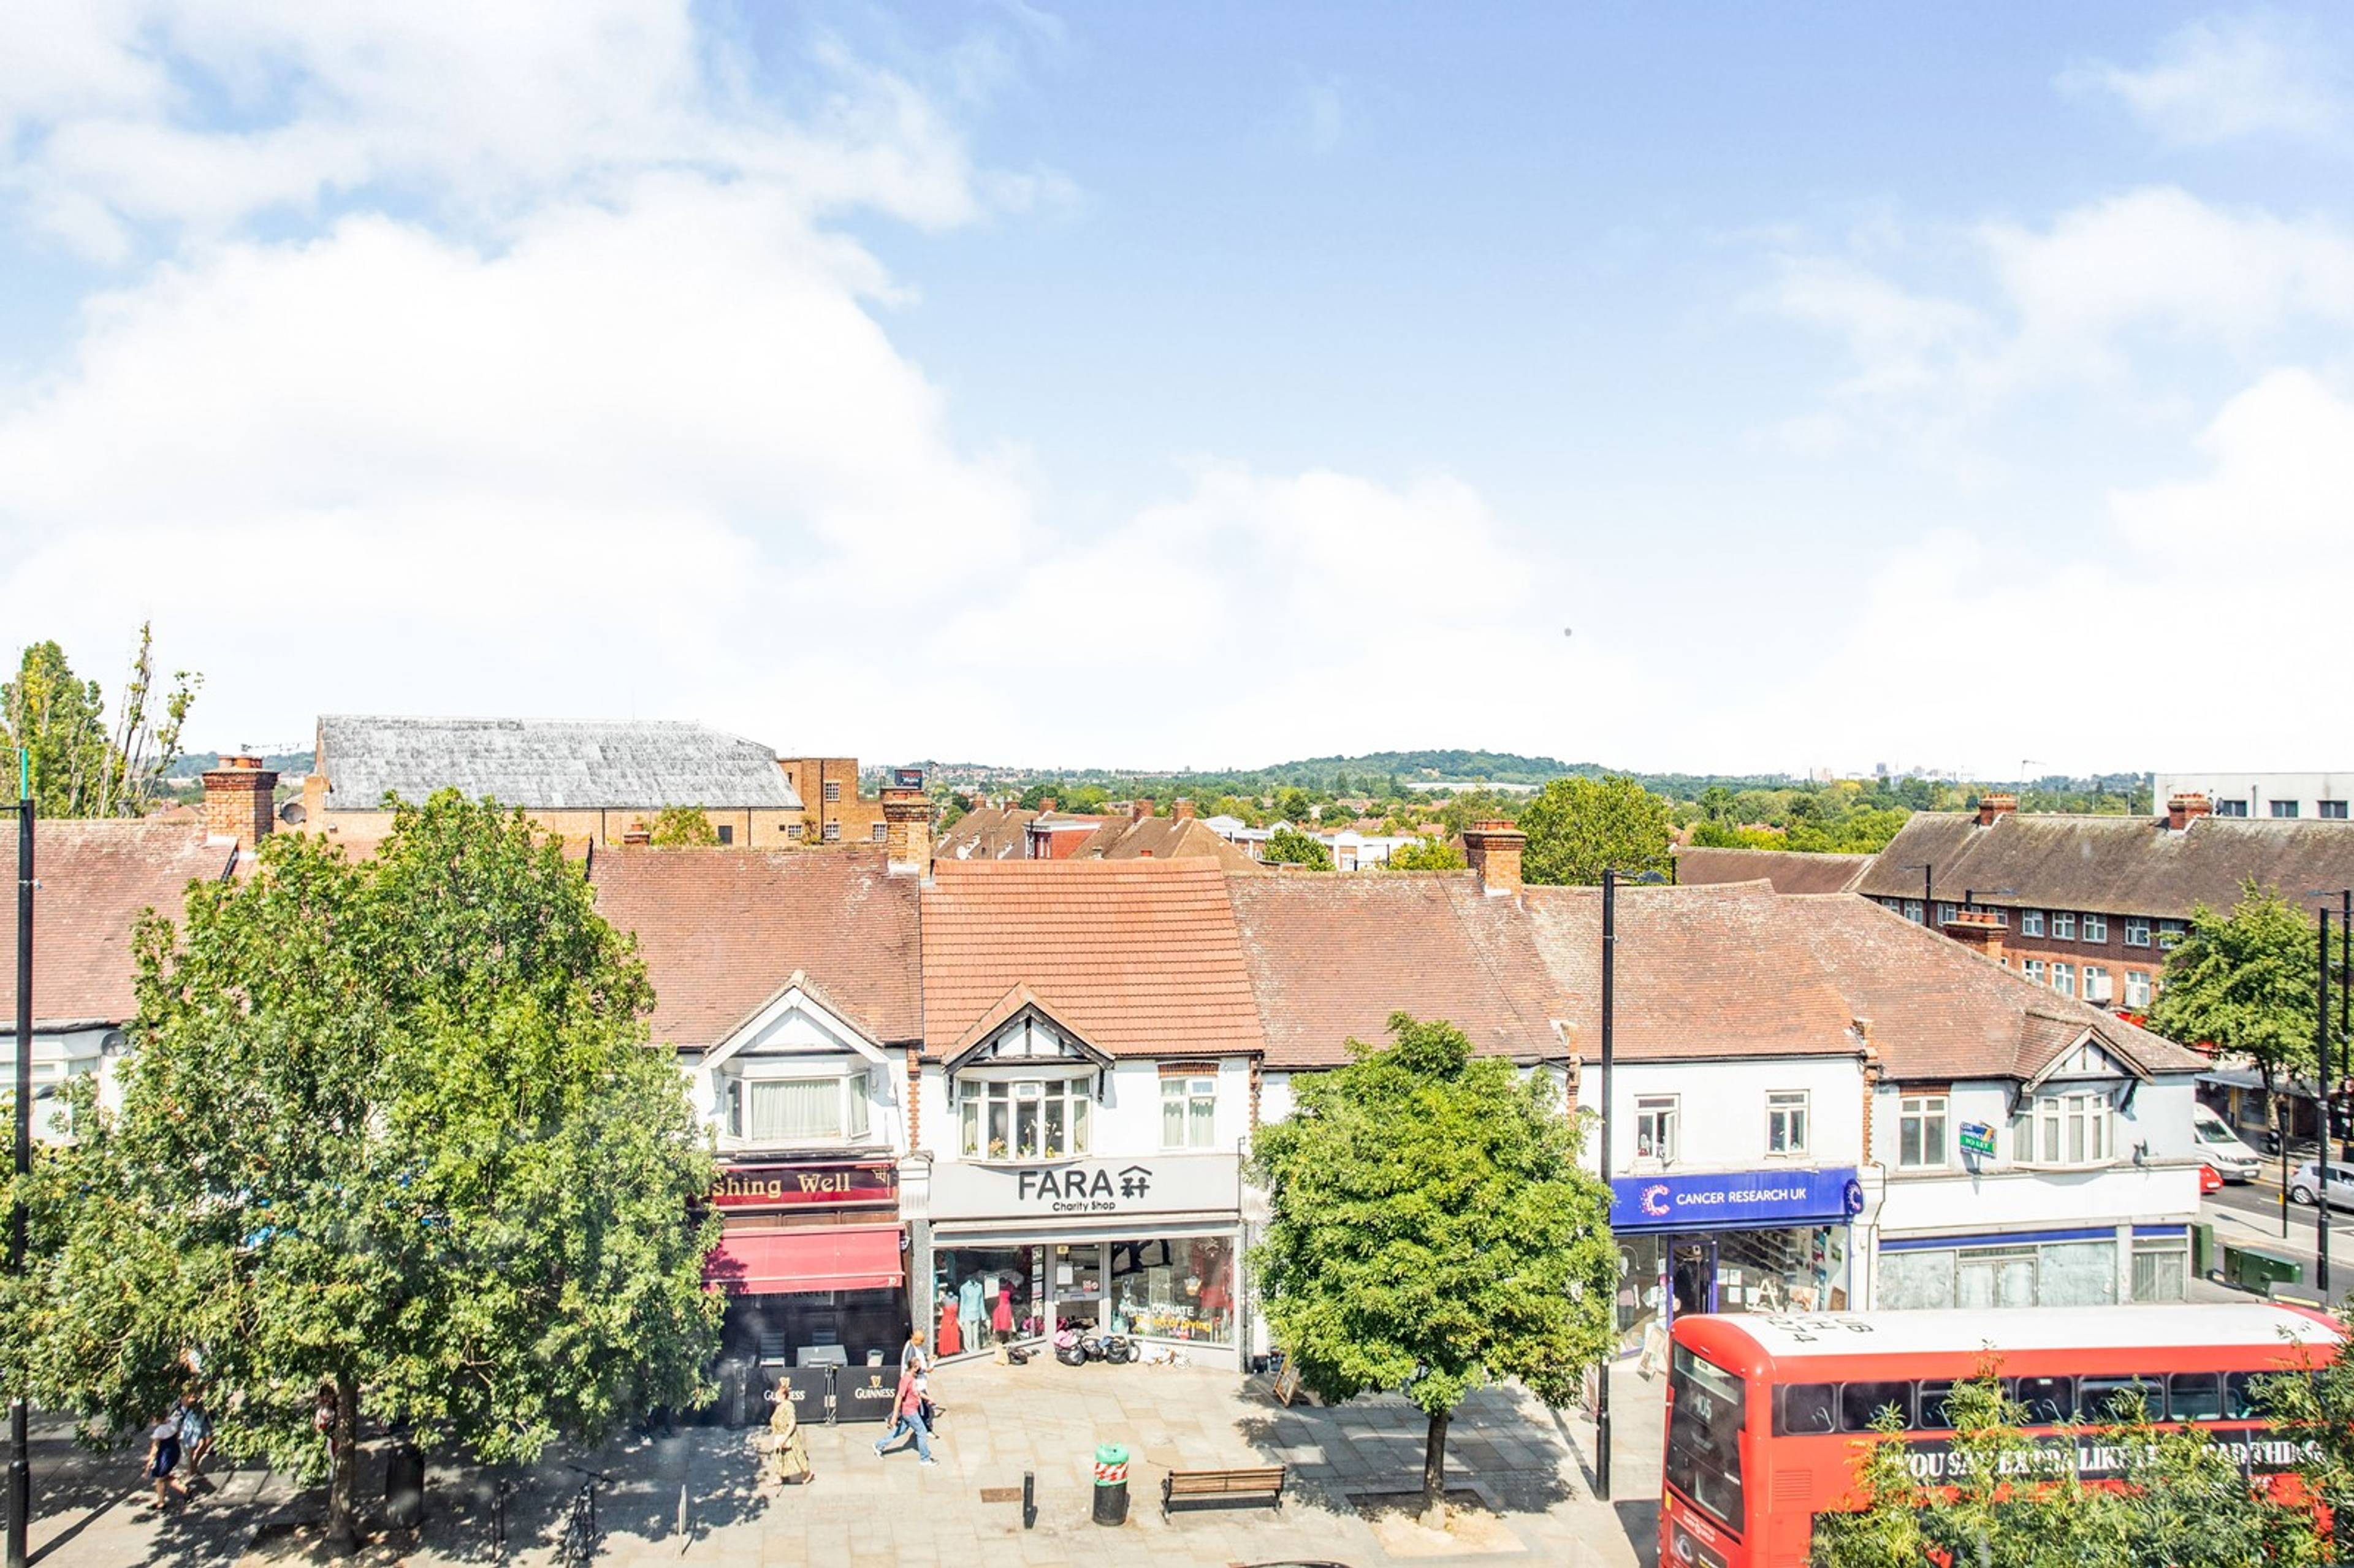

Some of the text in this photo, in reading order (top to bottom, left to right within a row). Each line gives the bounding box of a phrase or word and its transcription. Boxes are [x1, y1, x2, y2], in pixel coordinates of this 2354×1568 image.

[704, 1173, 851, 1198] shing Well
[1019, 1168, 1113, 1200] FARA
[1676, 1187, 1807, 1206] CANCER RESEARCH UK
[1052, 1200, 1116, 1212] Charity Shop
[1151, 1303, 1194, 1317] DONATE
[764, 1389, 806, 1401] GUESS
